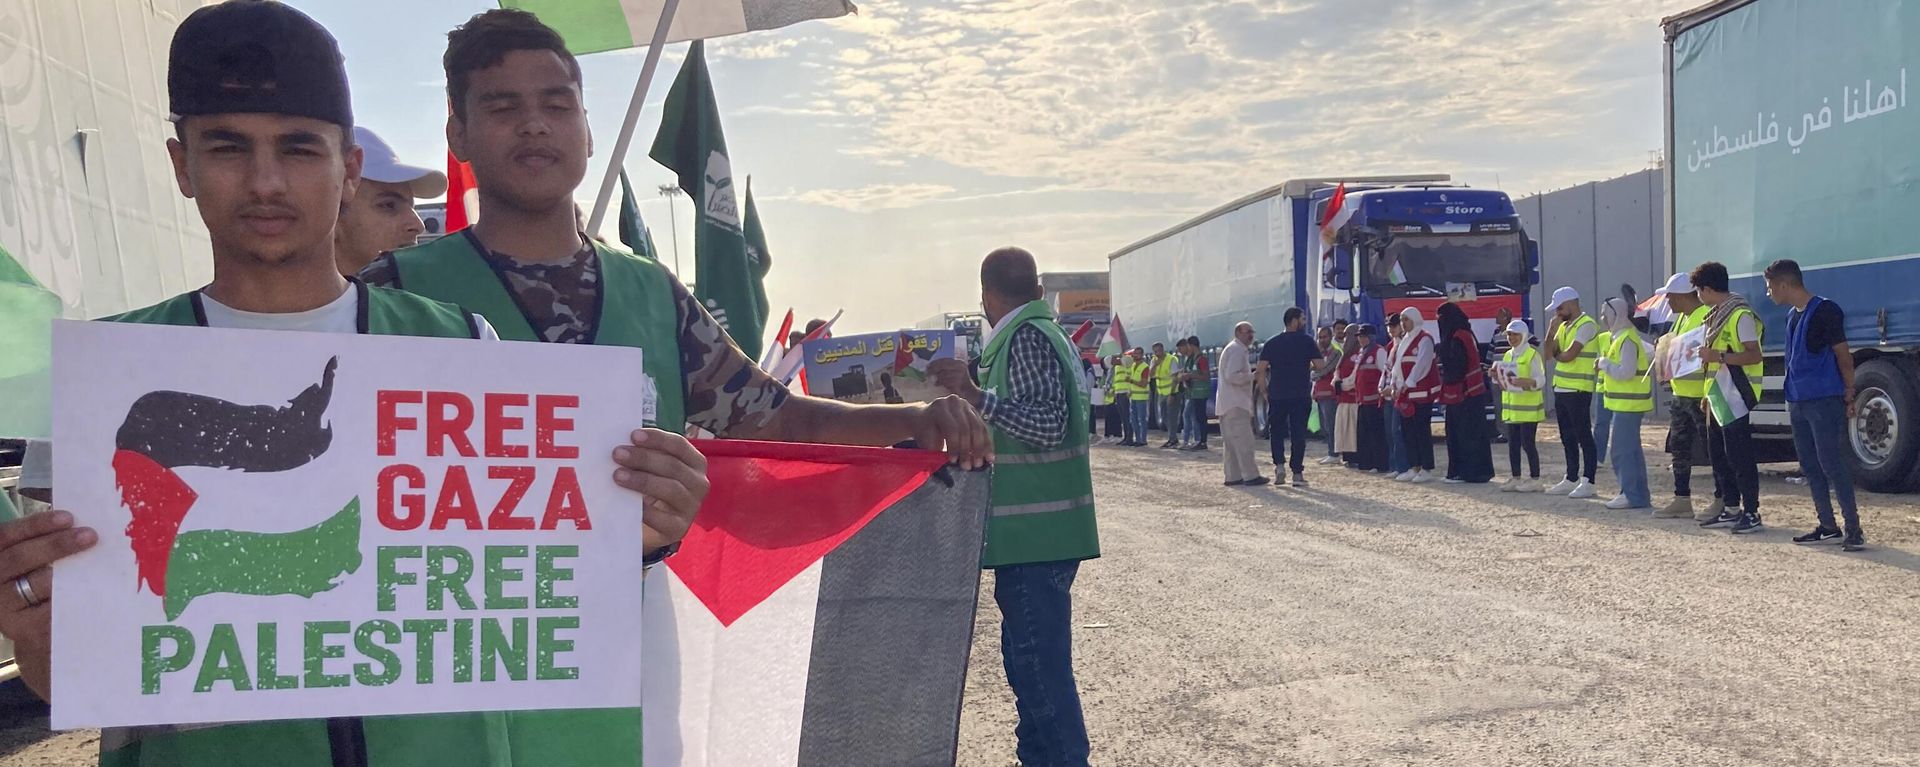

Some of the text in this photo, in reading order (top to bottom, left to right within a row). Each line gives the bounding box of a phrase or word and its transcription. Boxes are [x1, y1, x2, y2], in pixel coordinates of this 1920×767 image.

[1687, 67, 1906, 173] اهلنا في فلسطين
[815, 340, 866, 364] المدنيين
[872, 336, 894, 356] قتل
[377, 390, 580, 459] FREE
[377, 464, 592, 531] GAZA
[377, 545, 579, 612] FREE
[141, 616, 580, 695] PALESTINE
